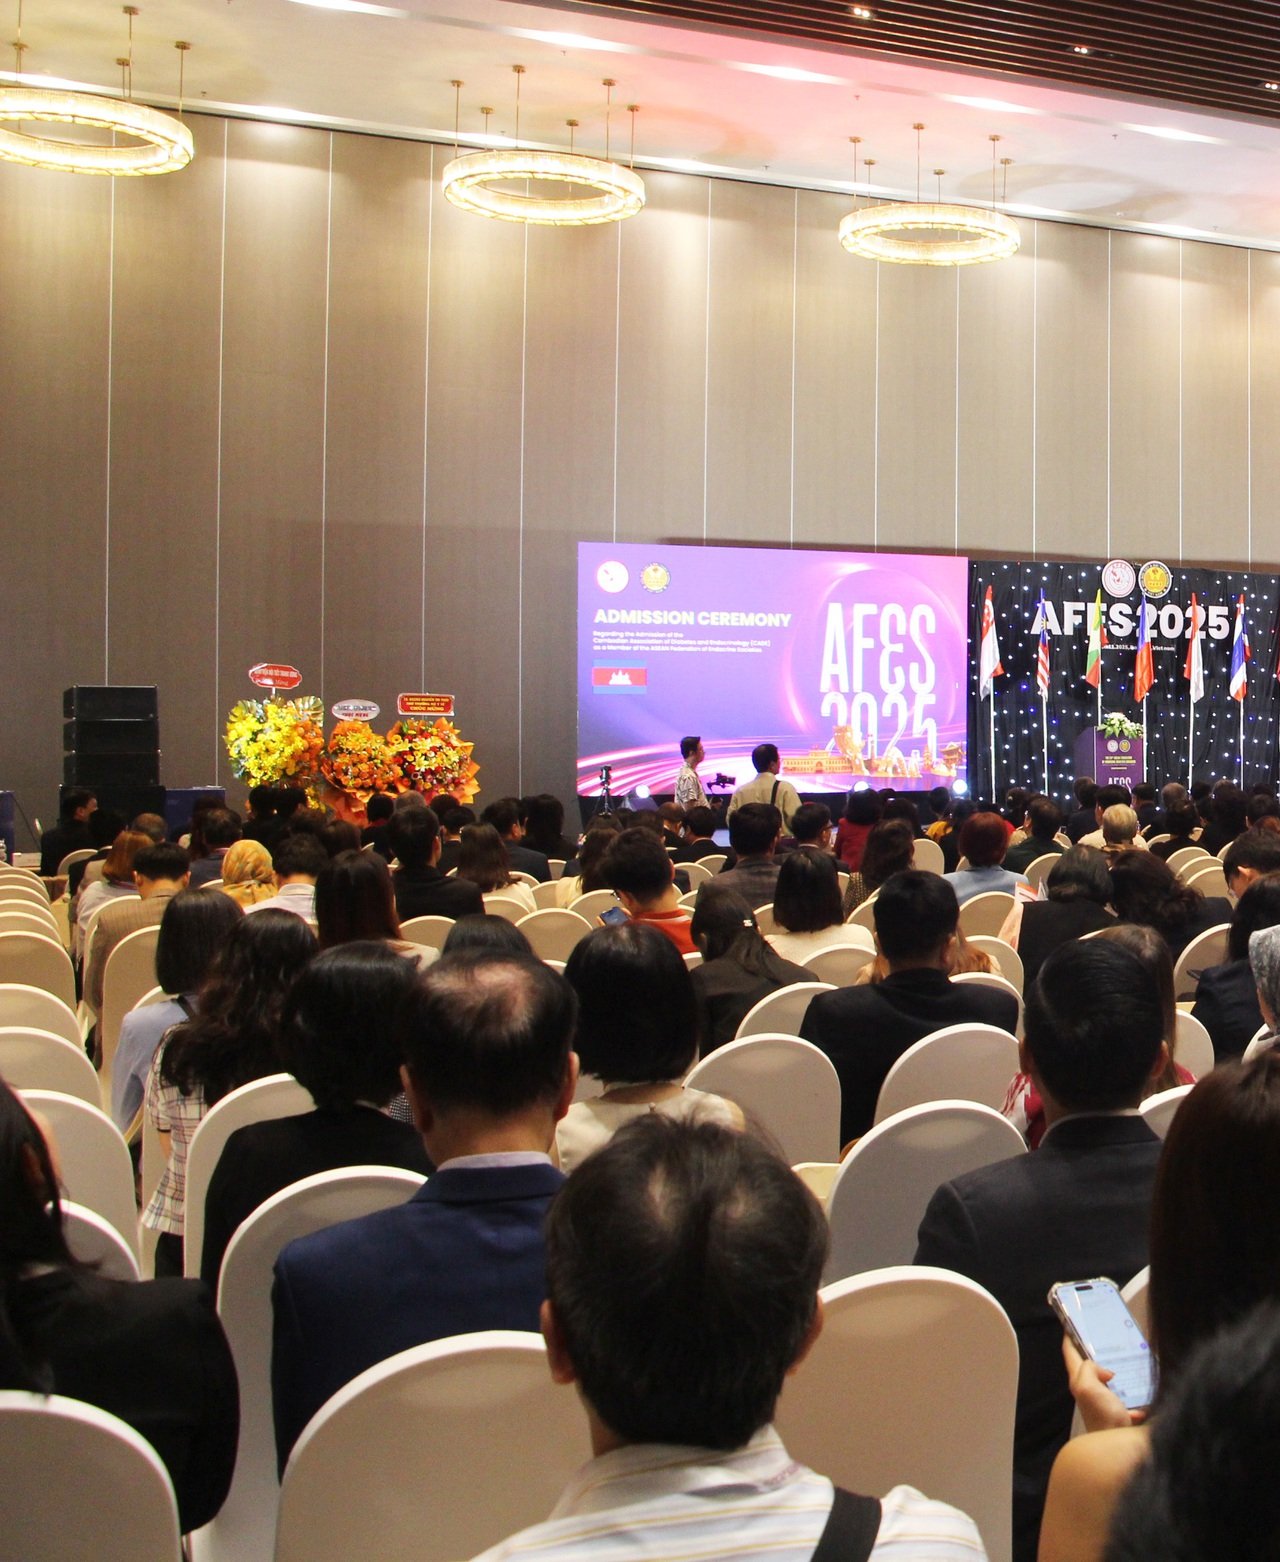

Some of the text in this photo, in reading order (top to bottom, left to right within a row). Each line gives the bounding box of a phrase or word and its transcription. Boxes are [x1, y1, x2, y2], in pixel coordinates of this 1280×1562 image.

[594, 608, 792, 628] ADMISSION CEREMONY
[820, 602, 936, 694] AFES
[820, 692, 937, 757] 2025
